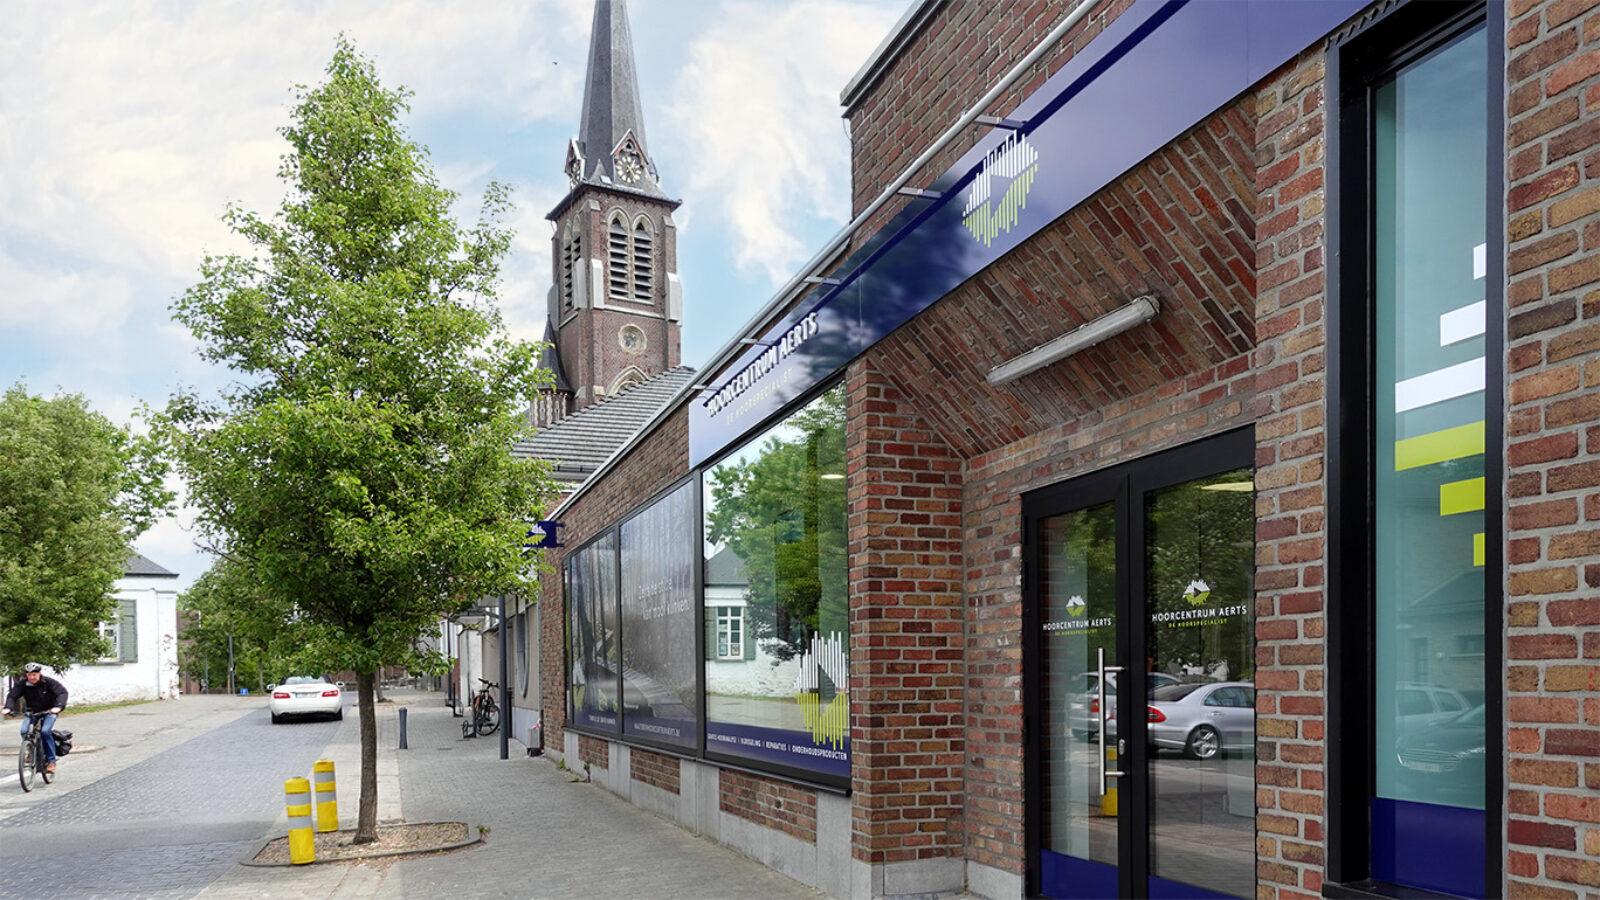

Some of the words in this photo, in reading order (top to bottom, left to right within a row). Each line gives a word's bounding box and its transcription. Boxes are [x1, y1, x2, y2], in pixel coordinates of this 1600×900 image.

[707, 345, 780, 417] HOORCENTRUM
[781, 312, 818, 359] AERTS
[1152, 608, 1216, 622] HOORCENTRUM
[1218, 605, 1248, 616] AERTS
[1043, 620, 1090, 631] HOORCENTRUM
[1091, 618, 1112, 628] AERTS
[1178, 618, 1228, 627] HOORSPECIALIST
[792, 745, 847, 760] ONDERHOUDSPRODUCTEN
